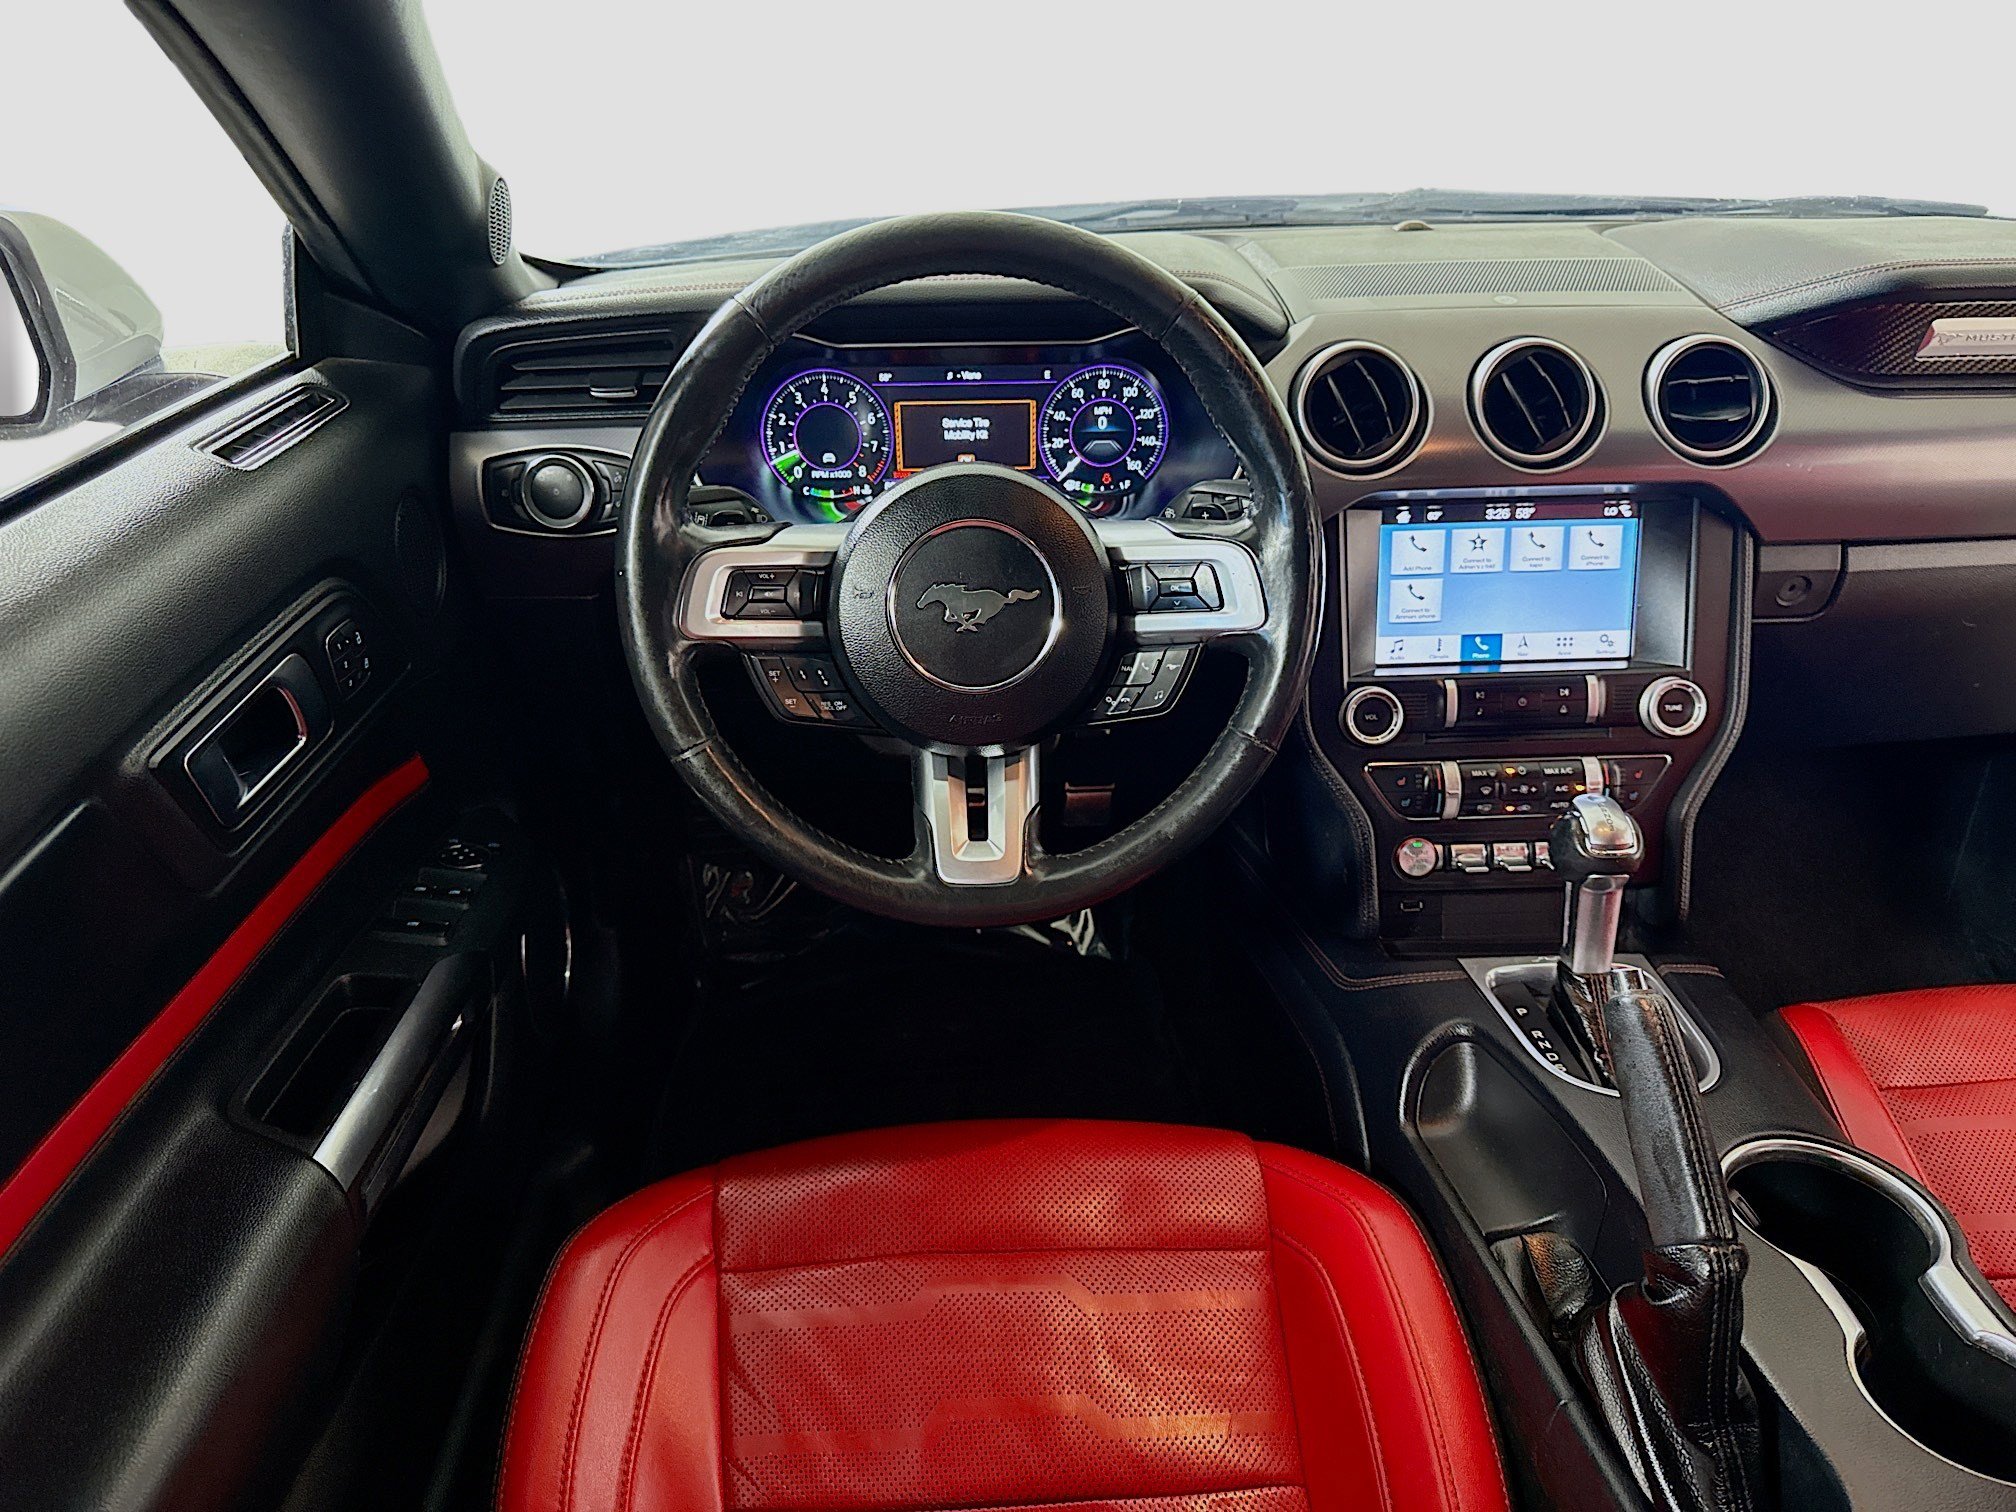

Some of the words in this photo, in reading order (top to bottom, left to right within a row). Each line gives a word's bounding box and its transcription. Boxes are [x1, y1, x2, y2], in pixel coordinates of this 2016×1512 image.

[820, 383, 829, 395] 4
[1097, 379, 1111, 390] 80
[794, 391, 803, 405] 3
[848, 391, 858, 404] 5
[1071, 387, 1084, 399] 60
[1122, 387, 1138, 398] 100
[1053, 410, 1066, 421] 40
[1093, 406, 1112, 416] MPH
[1139, 408, 1154, 419] 120
[778, 413, 786, 426] 2
[867, 412, 876, 425] 6
[1098, 416, 1107, 429] 0
[870, 440, 878, 453] 7
[1051, 437, 1064, 449] 20
[1141, 436, 1156, 447] 140
[778, 441, 786, 454] 1
[1126, 459, 1142, 471] 160
[793, 466, 803, 479] 0
[811, 470, 830, 479] RPM
[830, 470, 853, 479] x1000
[858, 465, 867, 478] 8
[802, 486, 810, 496] C
[853, 486, 861, 496] H
[1364, 713, 1379, 721] VOL
[1471, 769, 1488, 777] MAX
[1544, 767, 1560, 775] MAX
[1555, 785, 1569, 793] A/C
[1550, 801, 1569, 809] AUTO
[1516, 1008, 1528, 1016] P
[1531, 1030, 1545, 1039] R
[1537, 1040, 1552, 1049] N
[1545, 1052, 1560, 1062] D
